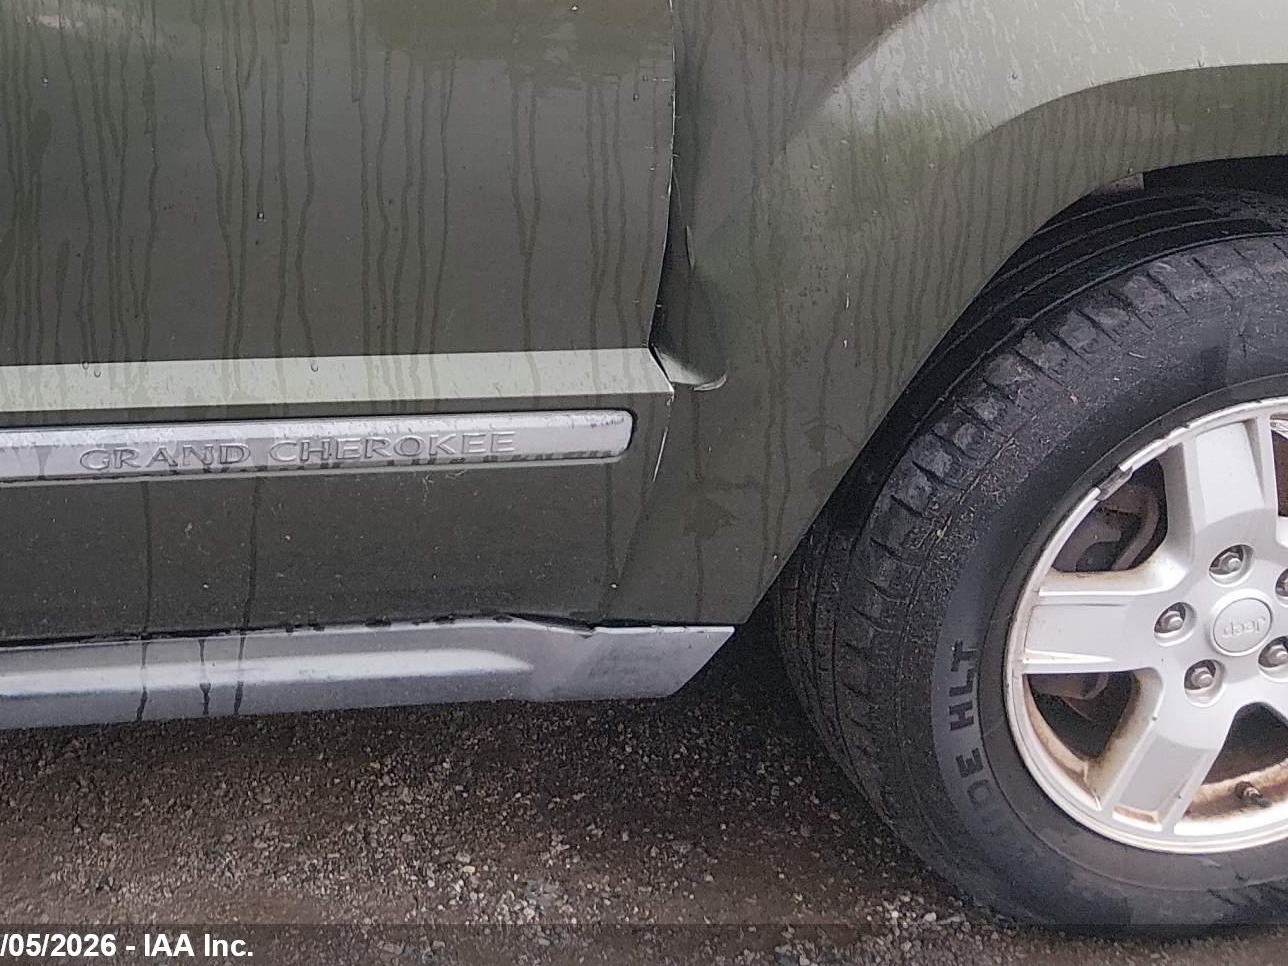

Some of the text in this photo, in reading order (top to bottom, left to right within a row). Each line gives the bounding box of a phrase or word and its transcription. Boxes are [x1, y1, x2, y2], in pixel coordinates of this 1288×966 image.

[79, 431, 517, 471] GRAND CHEROKEE
[948, 640, 979, 731] HLT
